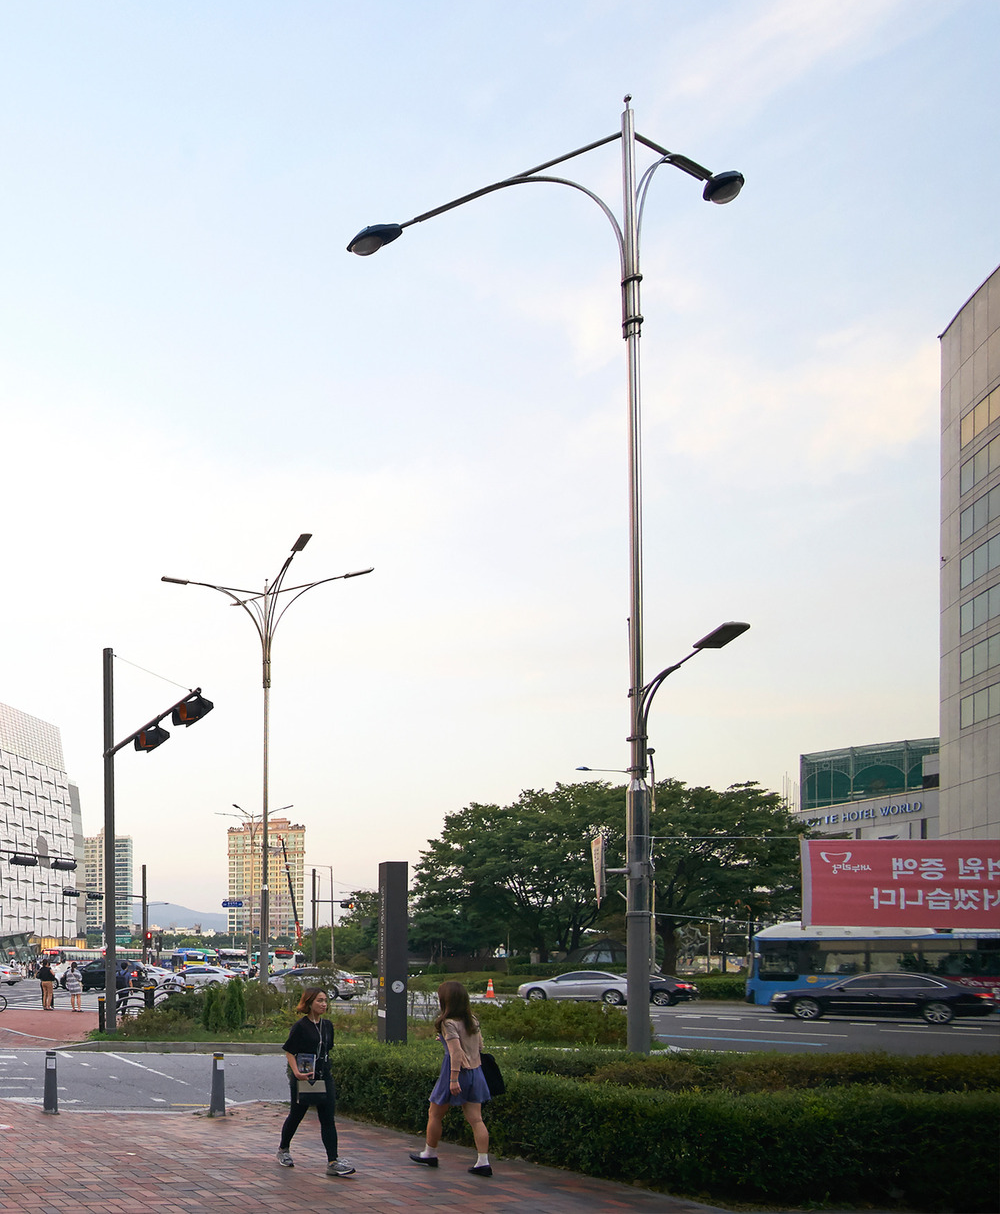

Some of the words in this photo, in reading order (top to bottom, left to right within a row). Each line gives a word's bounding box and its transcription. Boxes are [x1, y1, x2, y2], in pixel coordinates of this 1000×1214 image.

[801, 814, 838, 827] OTTE
[841, 808, 877, 823] HOTEL
[880, 801, 922, 817] WORLD
